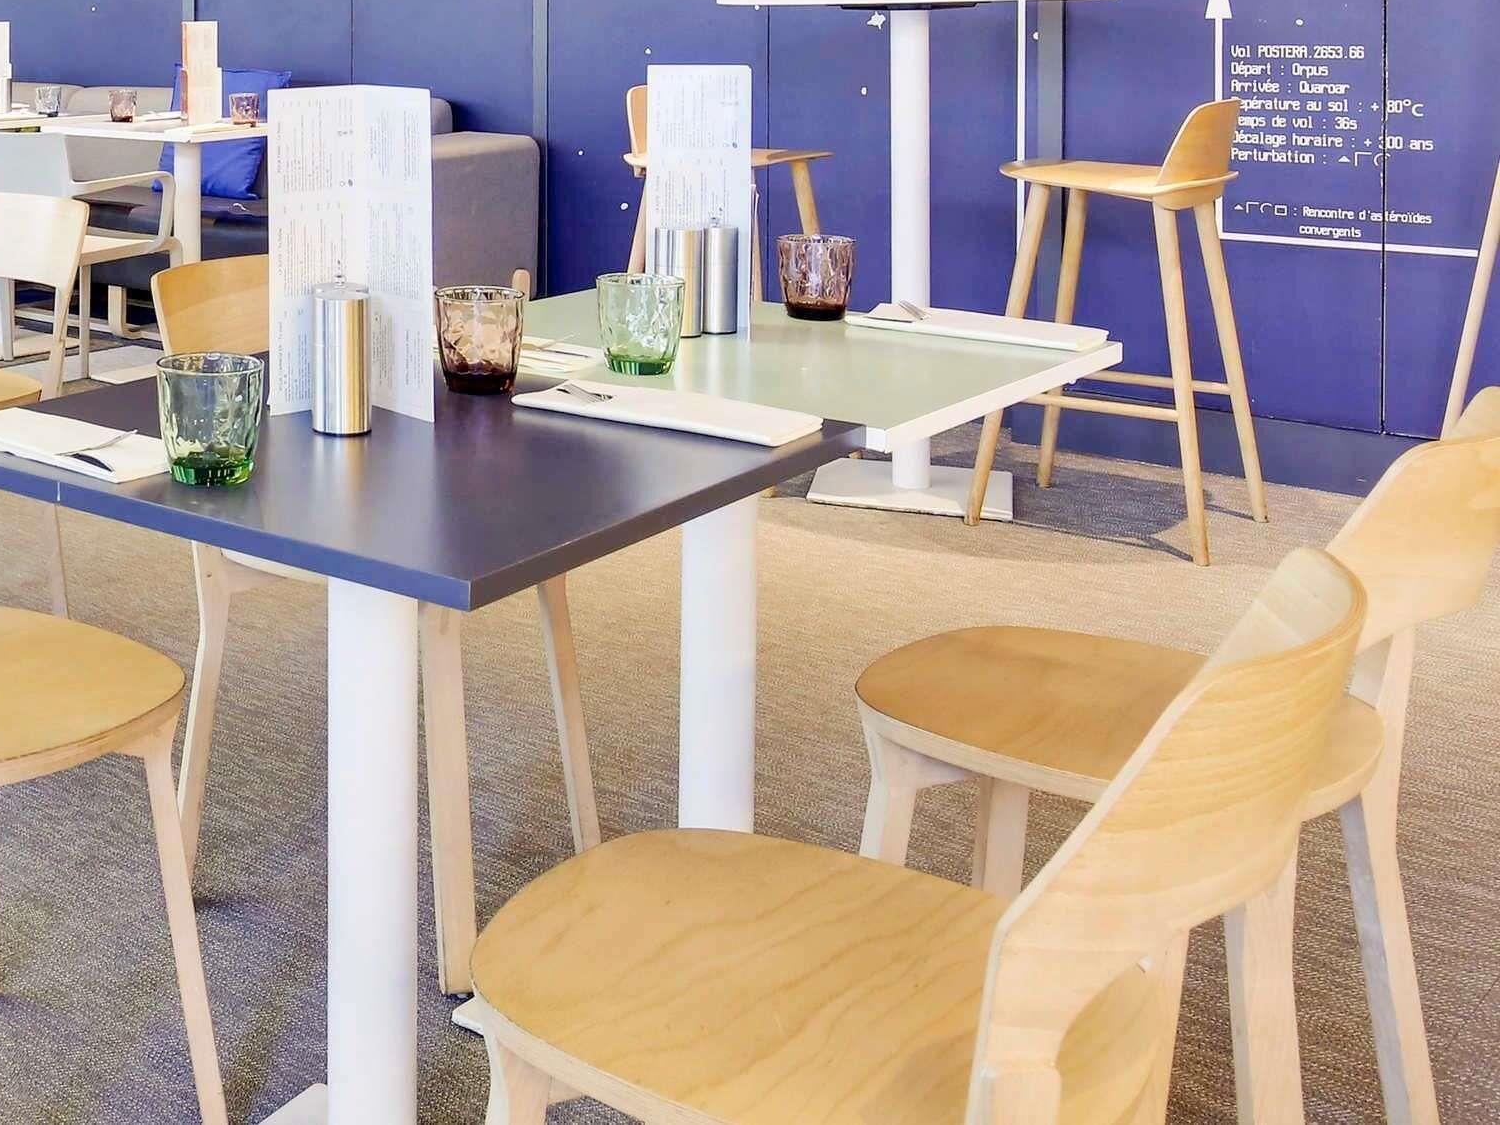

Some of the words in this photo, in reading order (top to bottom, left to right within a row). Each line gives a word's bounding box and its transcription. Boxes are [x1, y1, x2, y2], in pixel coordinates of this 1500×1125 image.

[1231, 45, 1250, 58] Vol
[1258, 45, 1365, 59] POSTERA.2653.66
[1231, 61, 1271, 77] Départ
[1292, 63, 1329, 78] Orpus
[1231, 79, 1280, 93] Arrivée
[1306, 101, 1321, 111] au
[1328, 99, 1348, 112] sol
[1238, 116, 1266, 129] emps
[1272, 115, 1286, 127] de
[1292, 116, 1313, 129] vol
[1292, 133, 1343, 147] horaire
[1409, 139, 1434, 151] ans
[1231, 147, 1314, 164] Perturbation
[1302, 206, 1354, 220] Rencontre
[1299, 225, 1362, 238] convergents
